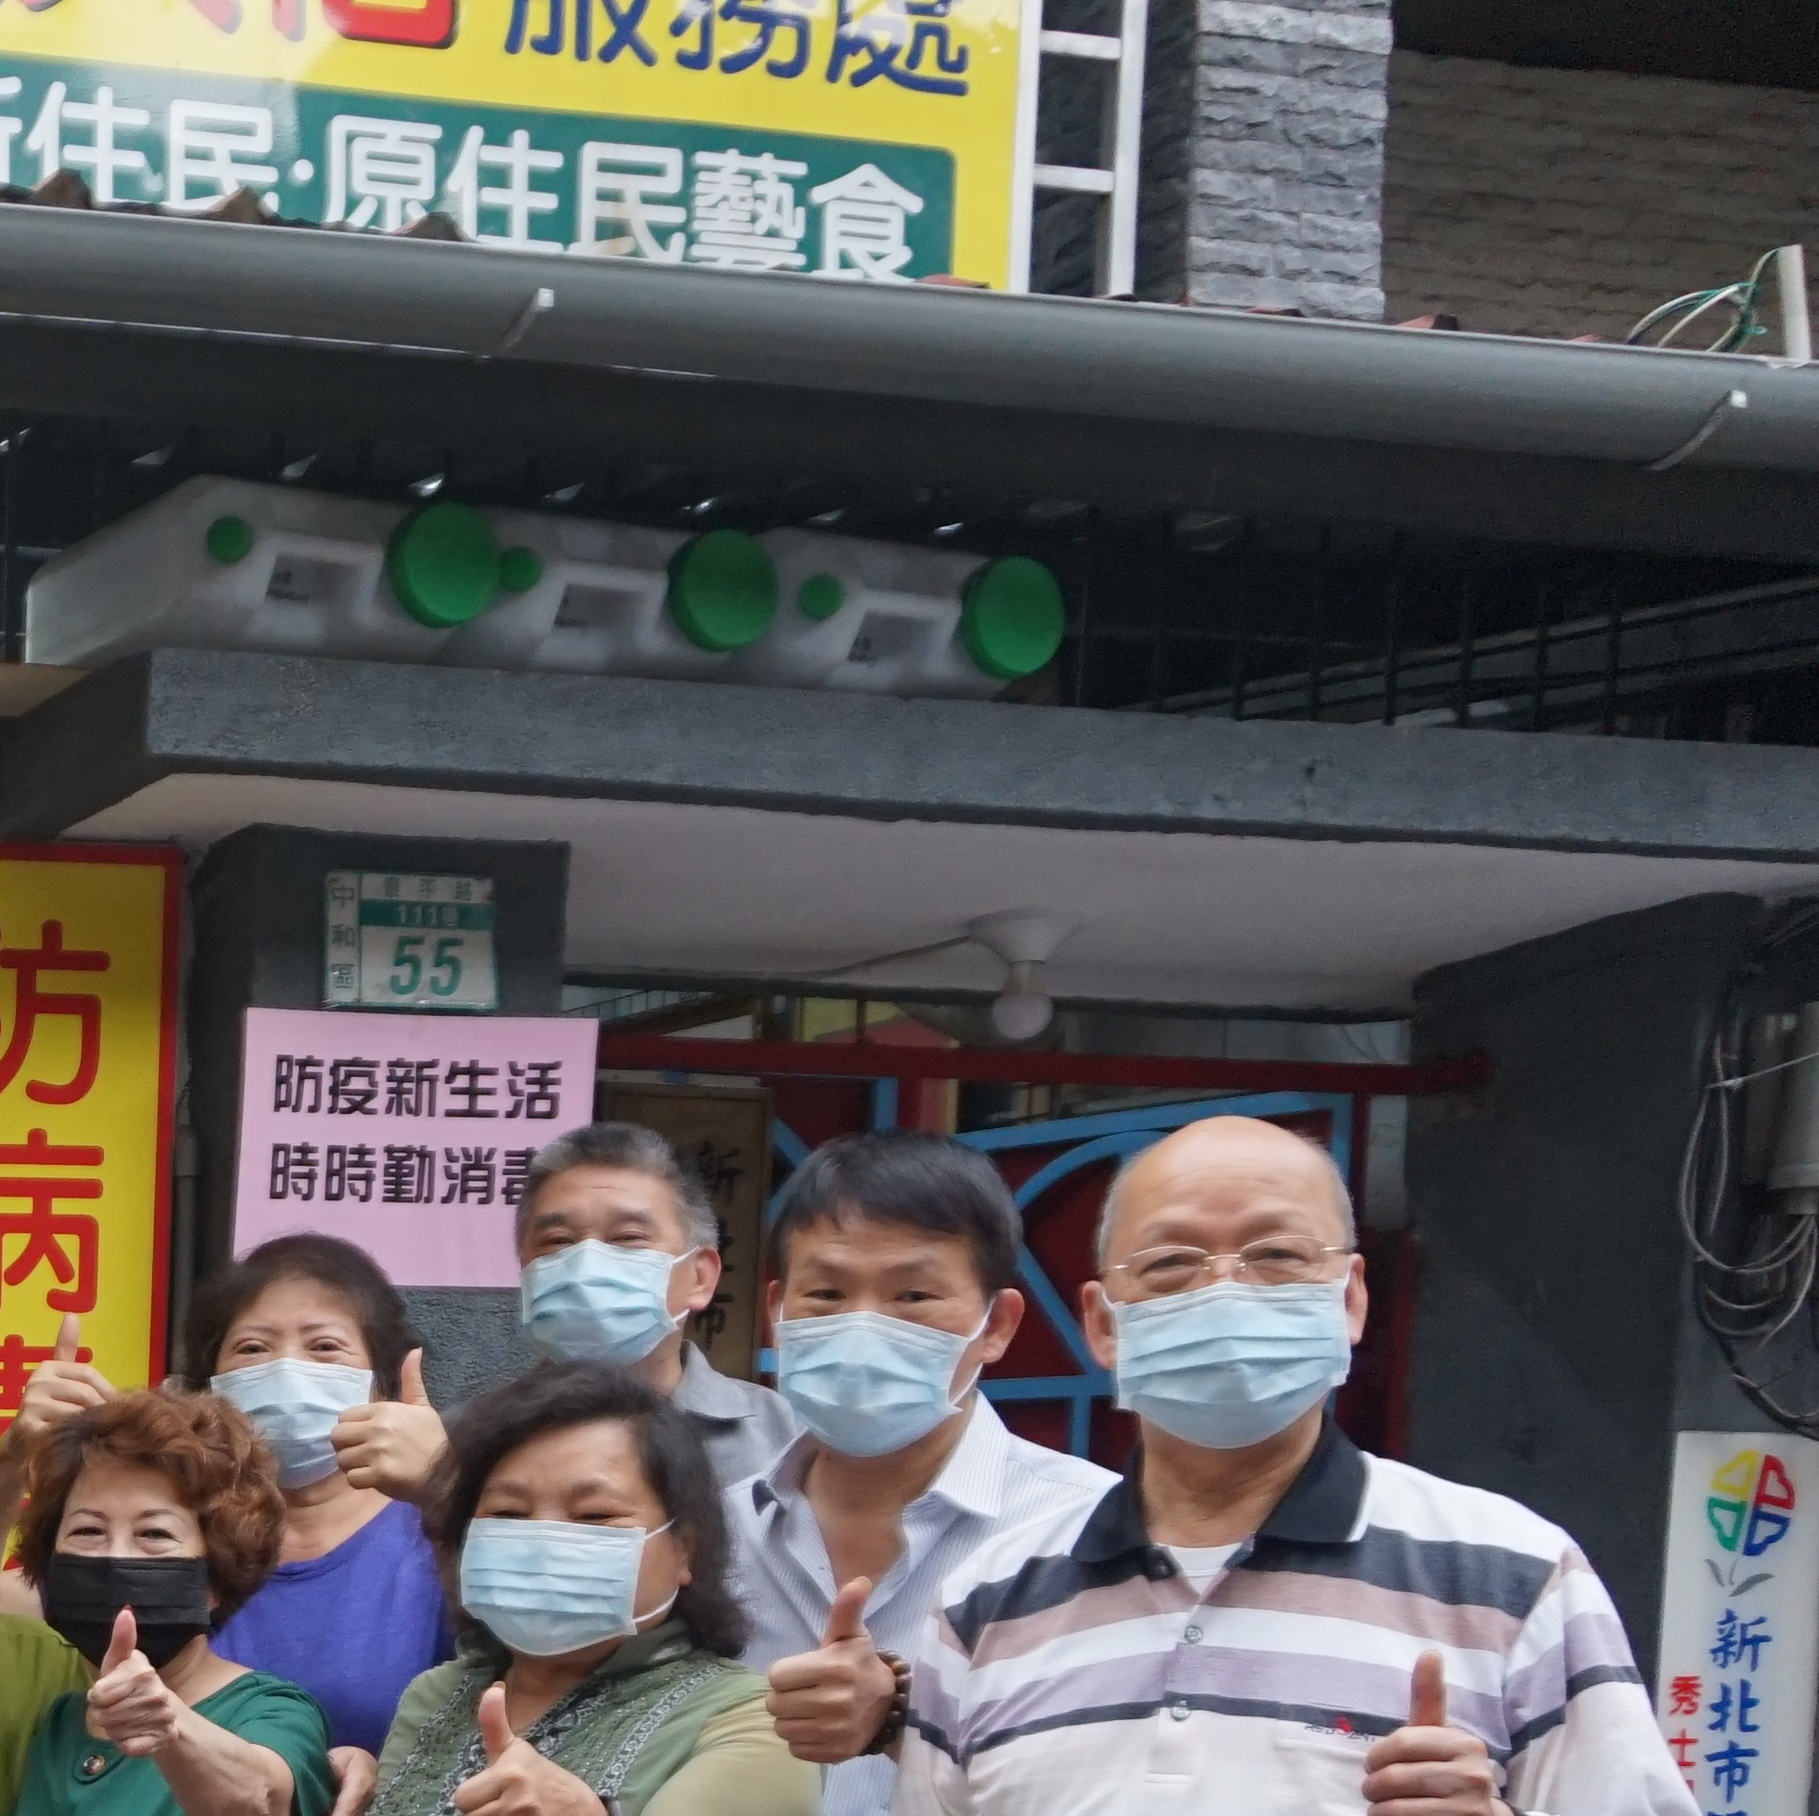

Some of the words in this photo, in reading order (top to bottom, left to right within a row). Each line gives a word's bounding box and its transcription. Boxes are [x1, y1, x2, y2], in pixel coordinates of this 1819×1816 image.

[329, 875, 356, 989] 中和區
[389, 935, 463, 997] 55
[272, 1054, 563, 1120] 防疫新生活
[1668, 1675, 1703, 1794] 秀士
